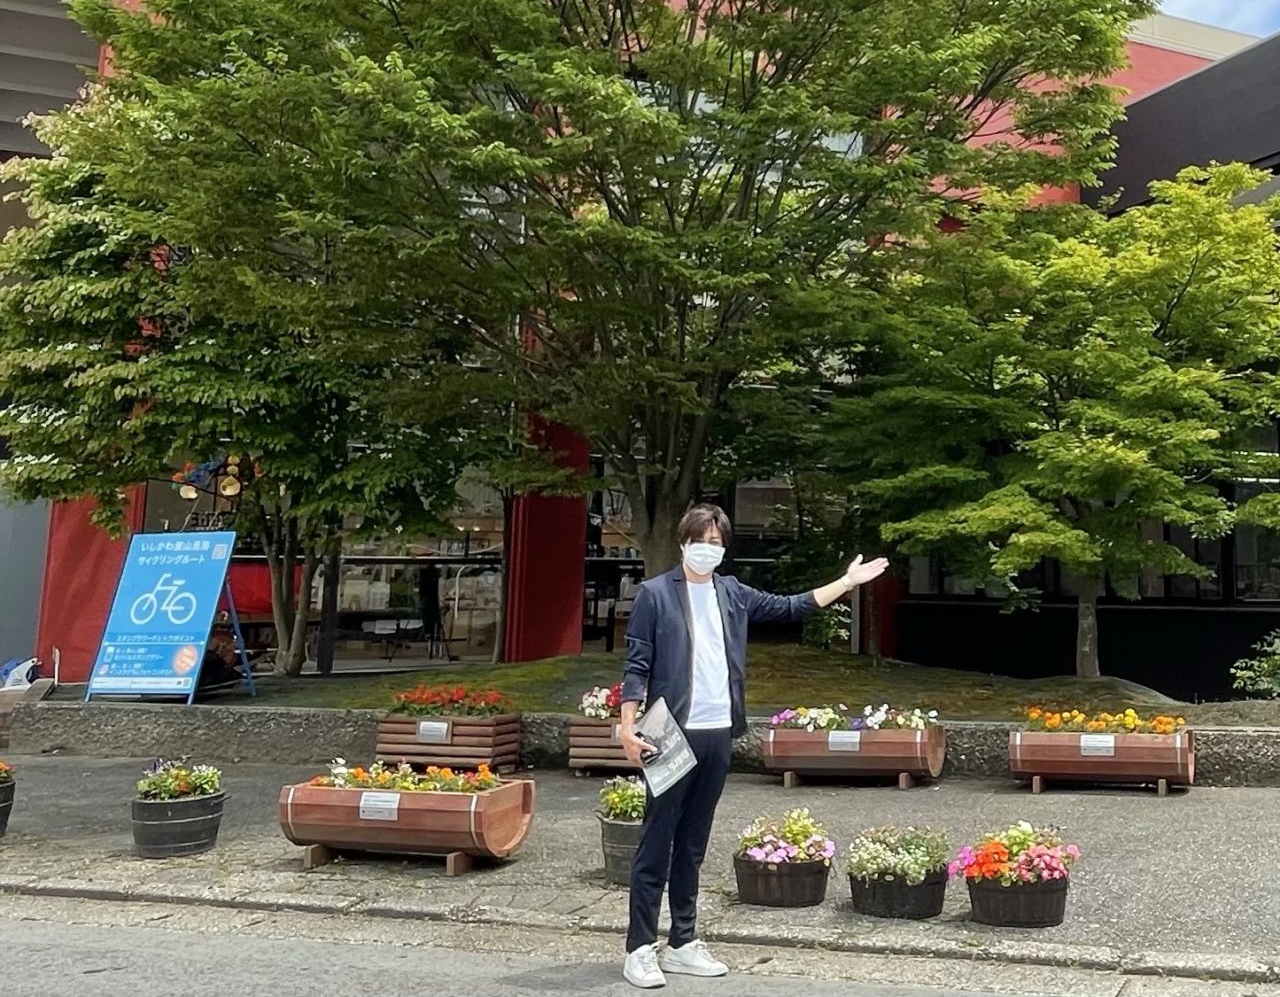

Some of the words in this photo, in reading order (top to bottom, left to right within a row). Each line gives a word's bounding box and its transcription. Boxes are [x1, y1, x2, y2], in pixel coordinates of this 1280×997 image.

[138, 554, 206, 566] サイクリングルート
